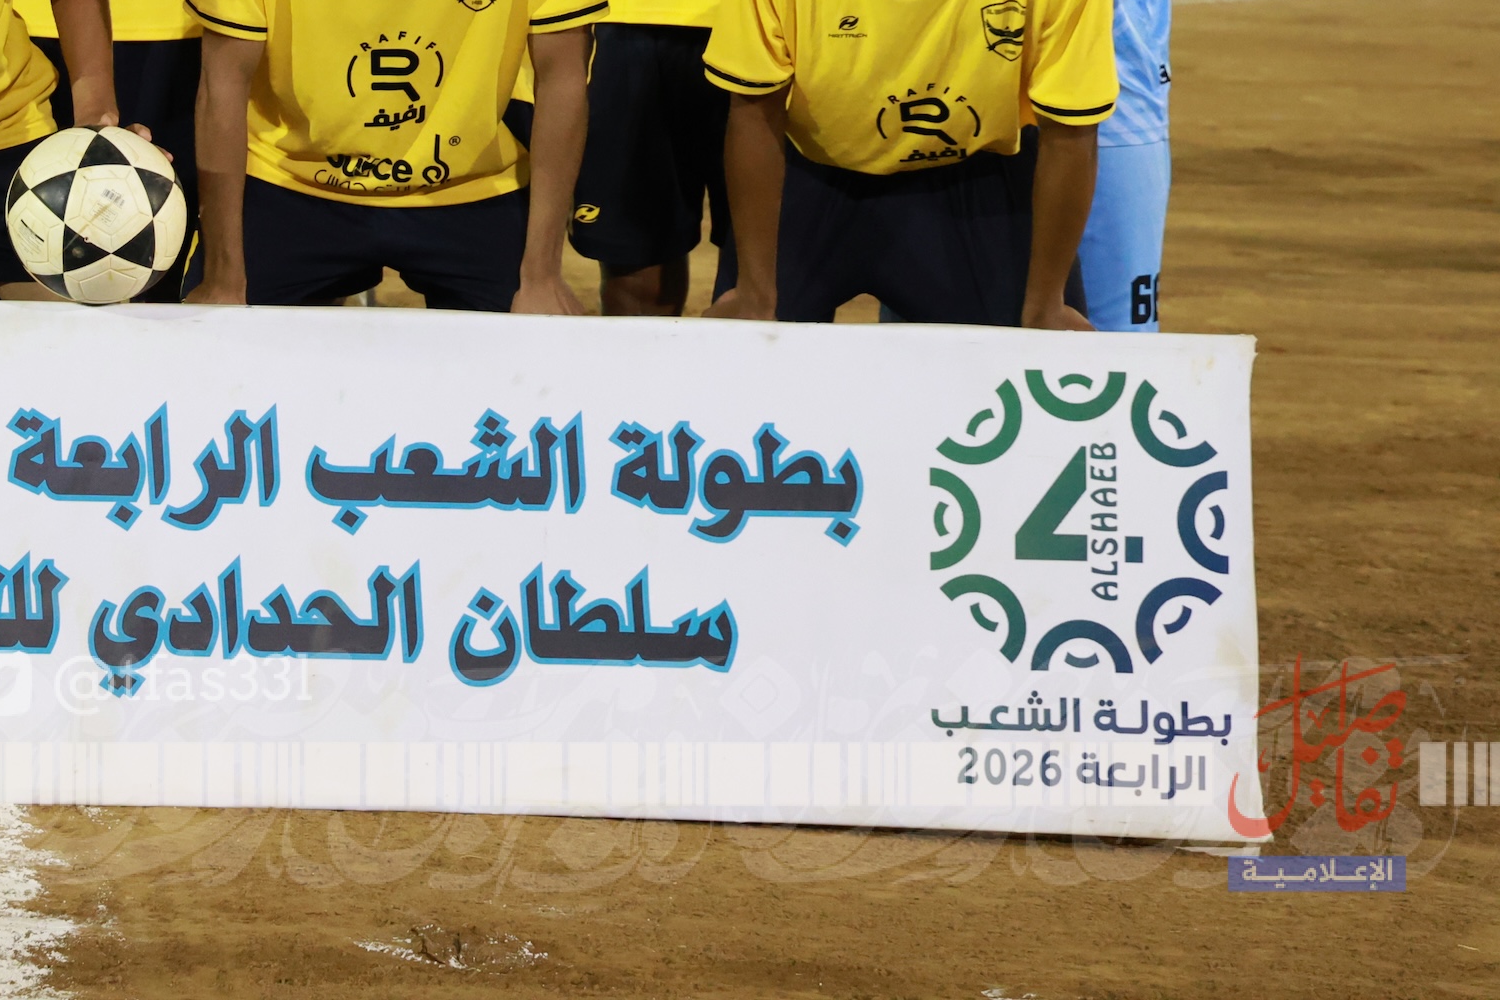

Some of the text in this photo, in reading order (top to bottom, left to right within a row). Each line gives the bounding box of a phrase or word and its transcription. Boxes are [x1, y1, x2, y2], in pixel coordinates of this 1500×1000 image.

[359, 30, 437, 52] RAFIF
[887, 83, 967, 104] RAFIF
[7, 401, 280, 532] الرابعة
[306, 408, 586, 536] الشعب
[609, 420, 863, 548] بطولة
[1090, 441, 1119, 601] ALSHAEB
[88, 555, 423, 698] الحدادي
[448, 561, 738, 688] سلطان
[931, 690, 1232, 746] بطولة الشعب
[957, 746, 1206, 800] الرابعة 2026
